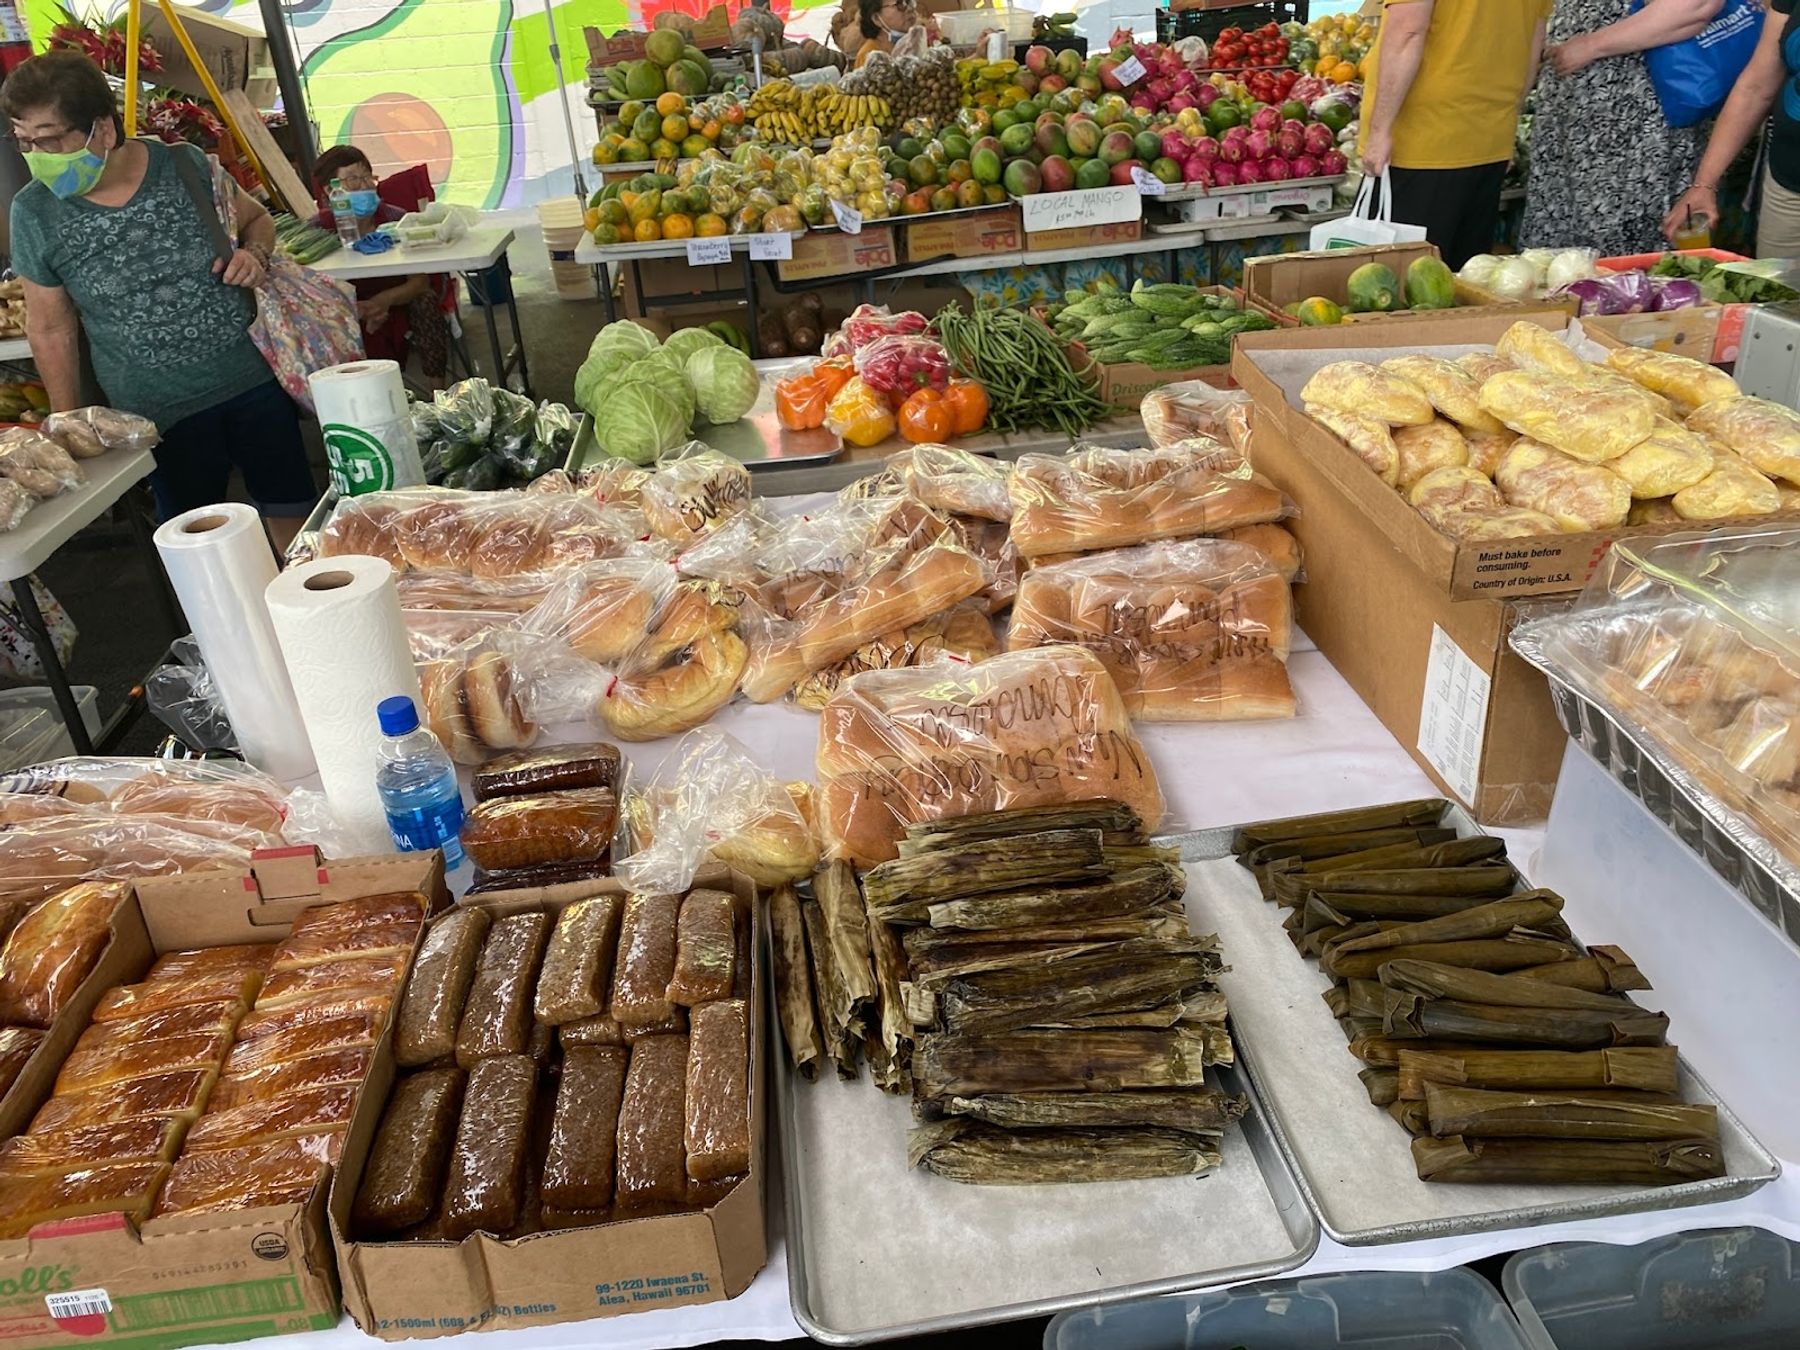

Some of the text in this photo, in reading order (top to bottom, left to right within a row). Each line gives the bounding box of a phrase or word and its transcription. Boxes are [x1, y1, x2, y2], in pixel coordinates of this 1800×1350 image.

[1695, 4, 1752, 40] almart
[1029, 190, 1126, 216] LOCAL MANGO
[855, 249, 891, 267] Dole
[1478, 547, 1562, 562] Must bake before
[1476, 560, 1532, 573] consuming.
[1473, 573, 1573, 590] Country of Origin: U.S.A.
[258, 1238, 281, 1247] USDA
[595, 1271, 710, 1295] 99-1220 Iwaena St.
[49, 1295, 81, 1305] 325515
[632, 1287, 673, 1301] Hawaii
[675, 1283, 711, 1297] 96701
[513, 1302, 557, 1316] Bottles
